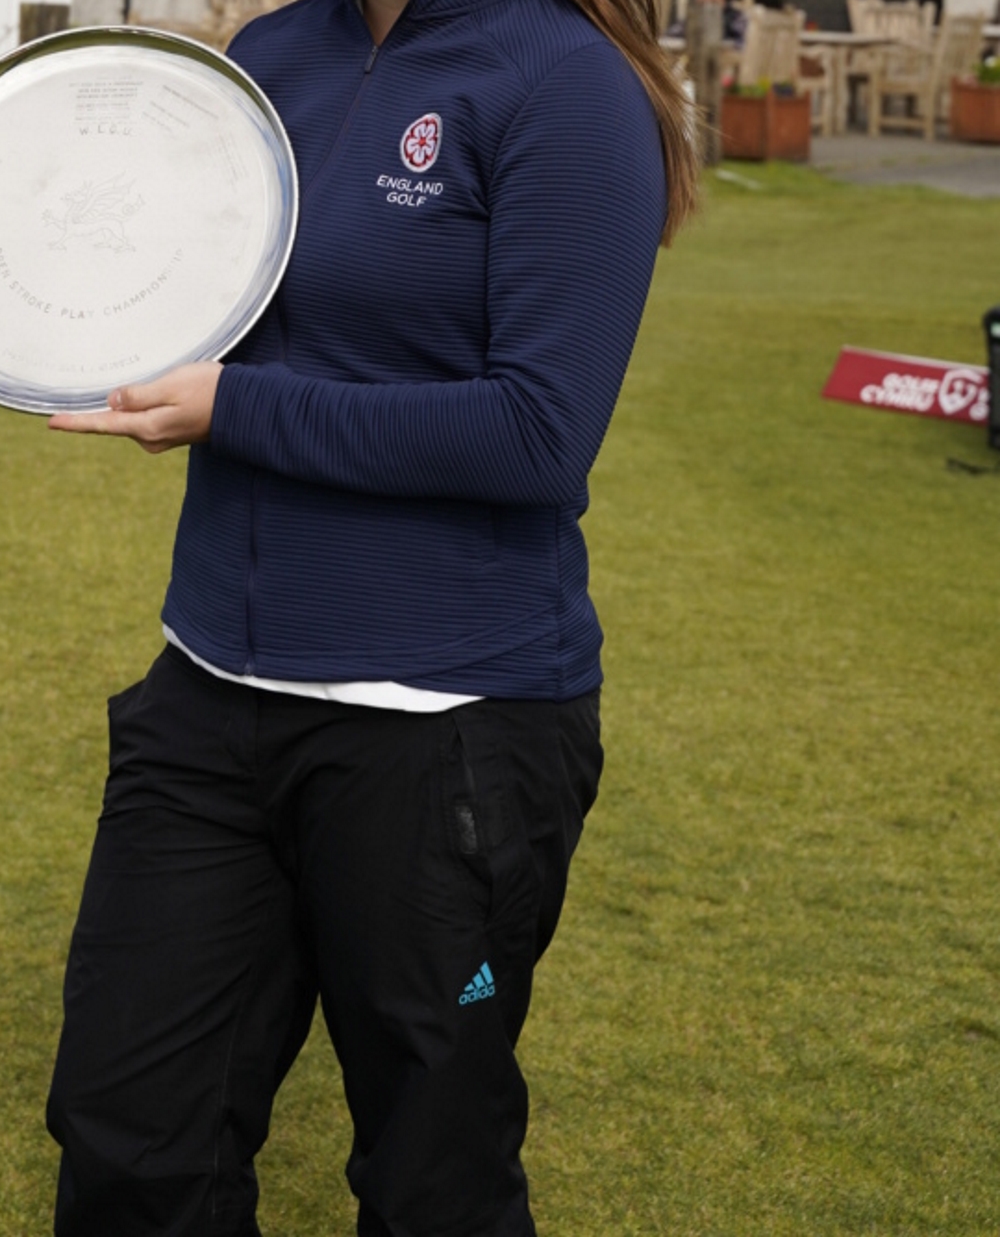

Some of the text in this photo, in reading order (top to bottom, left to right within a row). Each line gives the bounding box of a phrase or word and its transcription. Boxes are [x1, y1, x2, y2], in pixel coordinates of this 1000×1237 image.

[377, 174, 443, 195] ENGLAND
[386, 192, 427, 207] GOLF
[8, 280, 53, 314] STROKE
[60, 307, 96, 320] PLAY
[459, 984, 495, 1005] adidas
